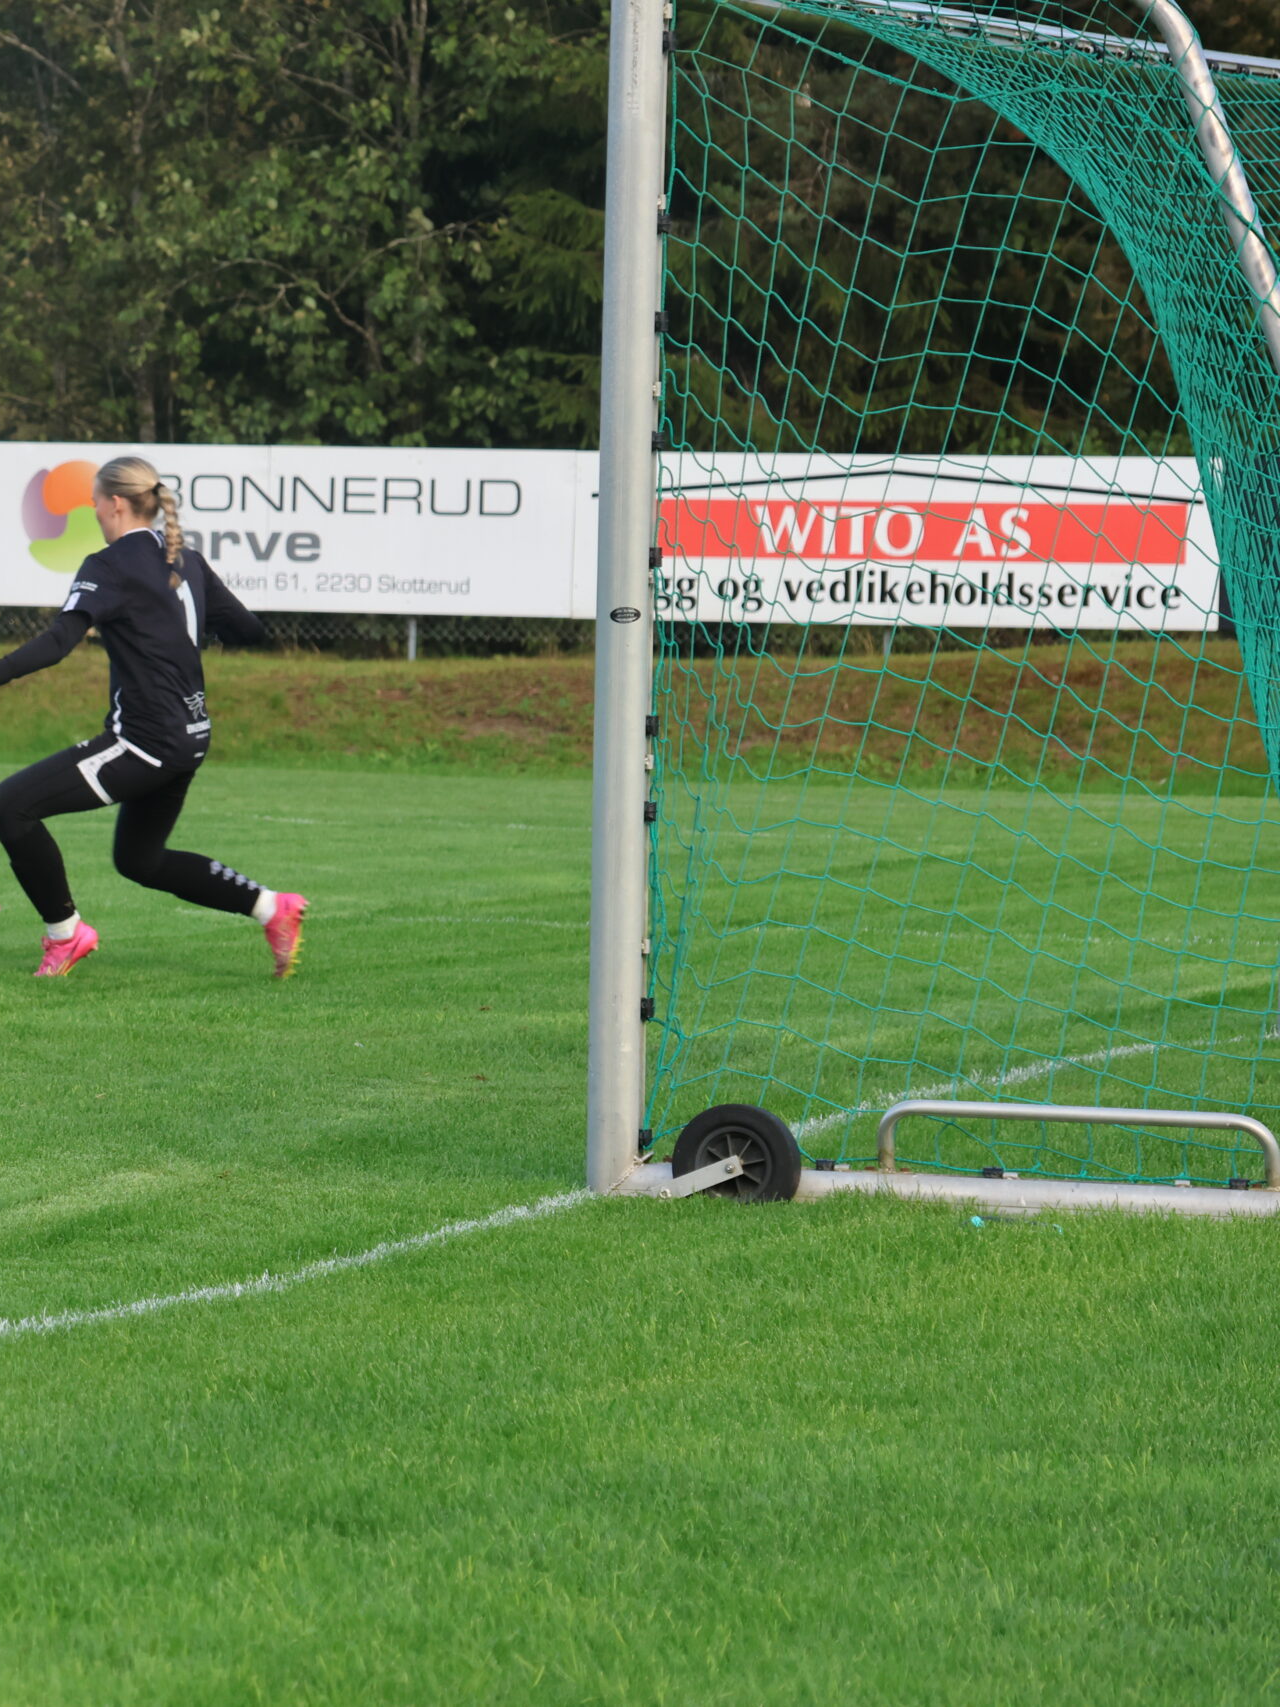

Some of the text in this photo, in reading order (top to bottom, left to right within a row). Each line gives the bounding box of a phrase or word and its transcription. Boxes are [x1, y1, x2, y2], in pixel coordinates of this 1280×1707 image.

[158, 521, 322, 562] arve
[952, 507, 1031, 558] AS
[223, 571, 268, 592] kken
[316, 572, 372, 593] 2230
[378, 574, 471, 595] Skotterud
[655, 570, 1182, 612] gg og vedlikeholdsservice
[176, 580, 197, 647] 1
